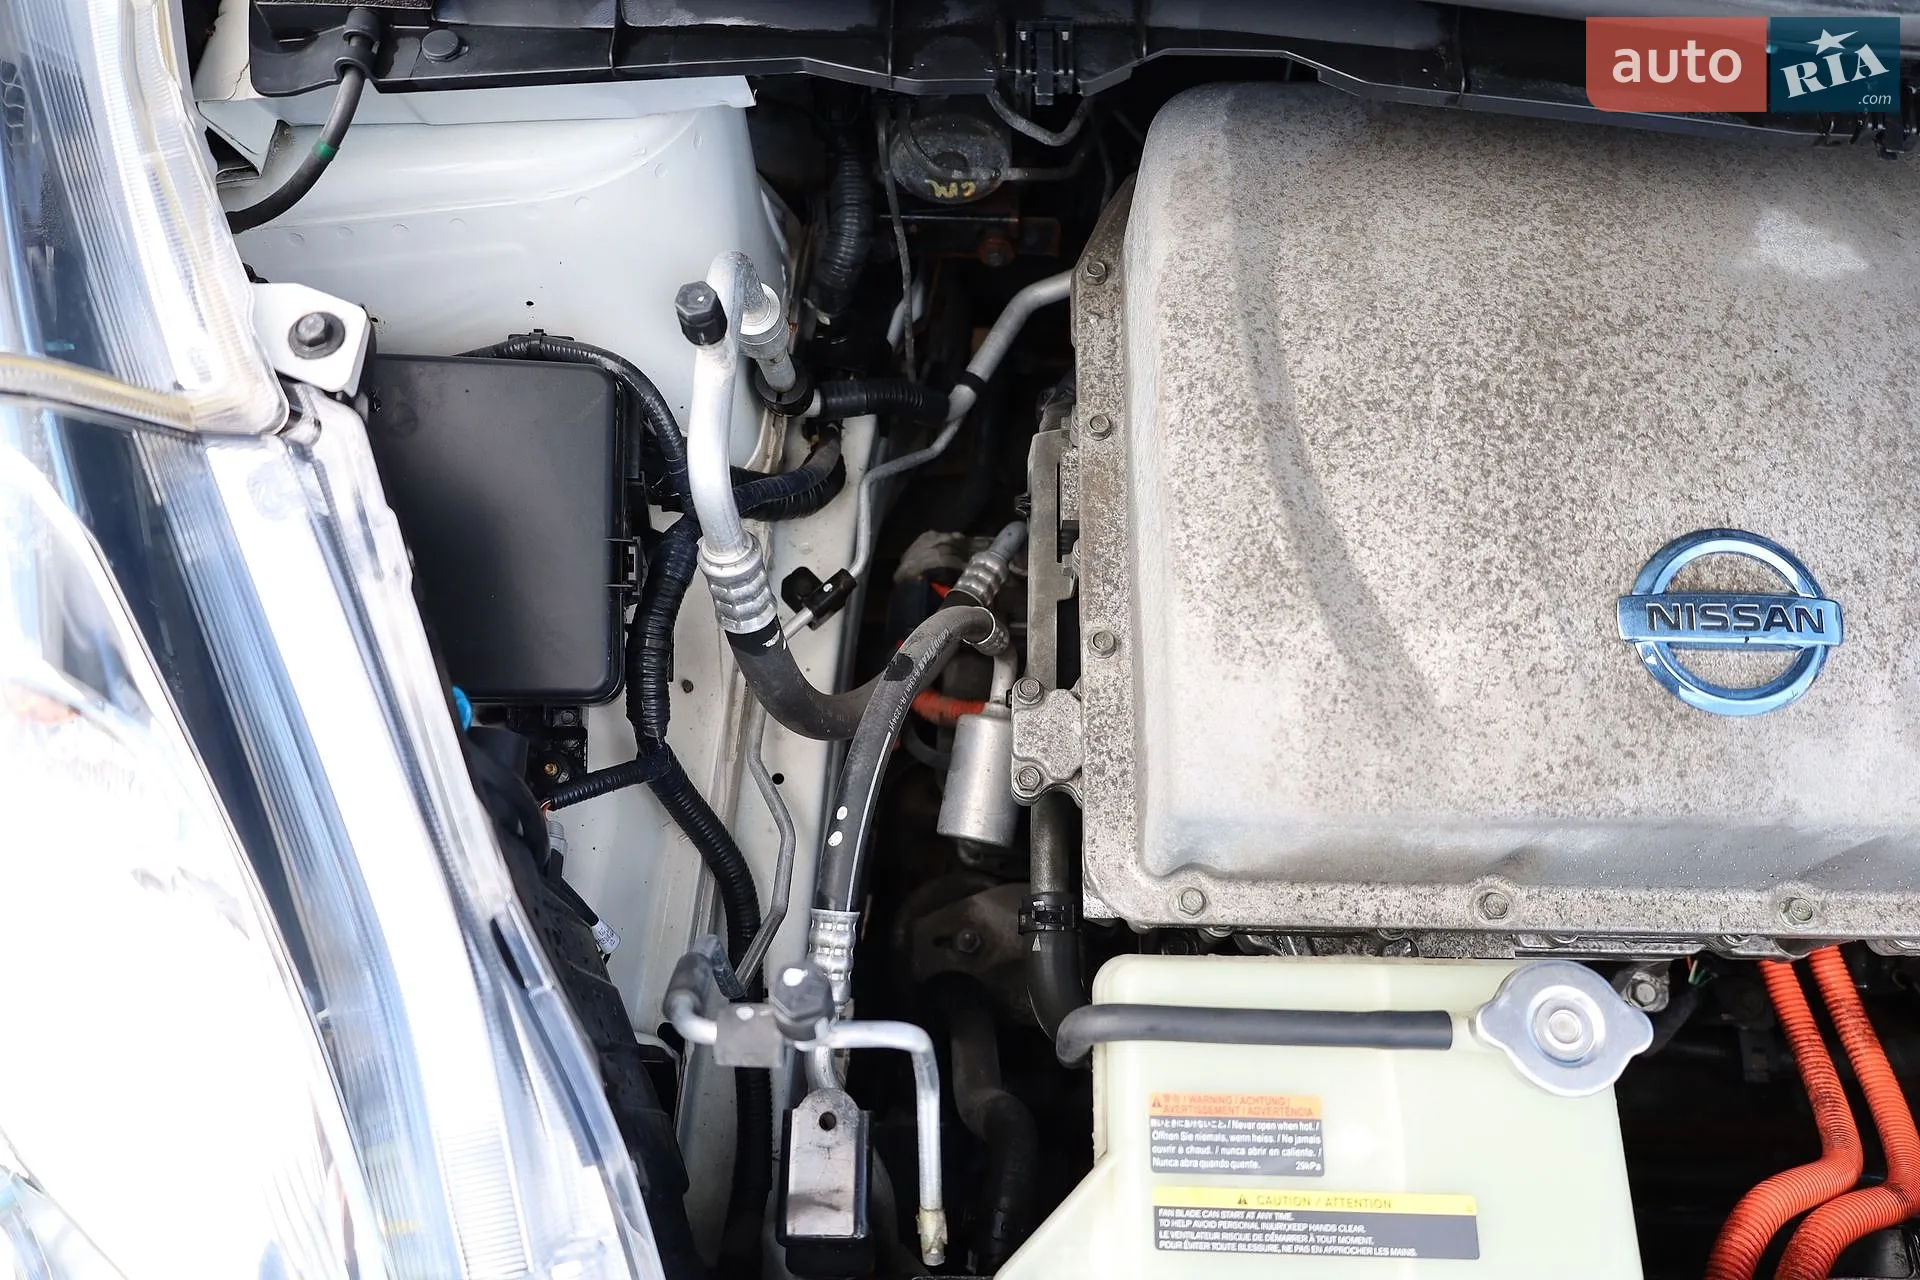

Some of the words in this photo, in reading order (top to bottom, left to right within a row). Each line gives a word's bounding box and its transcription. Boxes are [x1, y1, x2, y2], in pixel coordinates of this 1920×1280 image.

[1646, 602, 1825, 635] NISSAN
[888, 697, 907, 733] R-1234yf
[1188, 1095, 1232, 1105] WARNING
[1232, 1120, 1256, 1130] Never
[1257, 1194, 1311, 1207] CAUTION
[1325, 1196, 1392, 1209] ATTENTION
[1202, 1209, 1219, 1219] CAN
[1159, 1219, 1170, 1228] TO
[1159, 1230, 1170, 1239] LE
